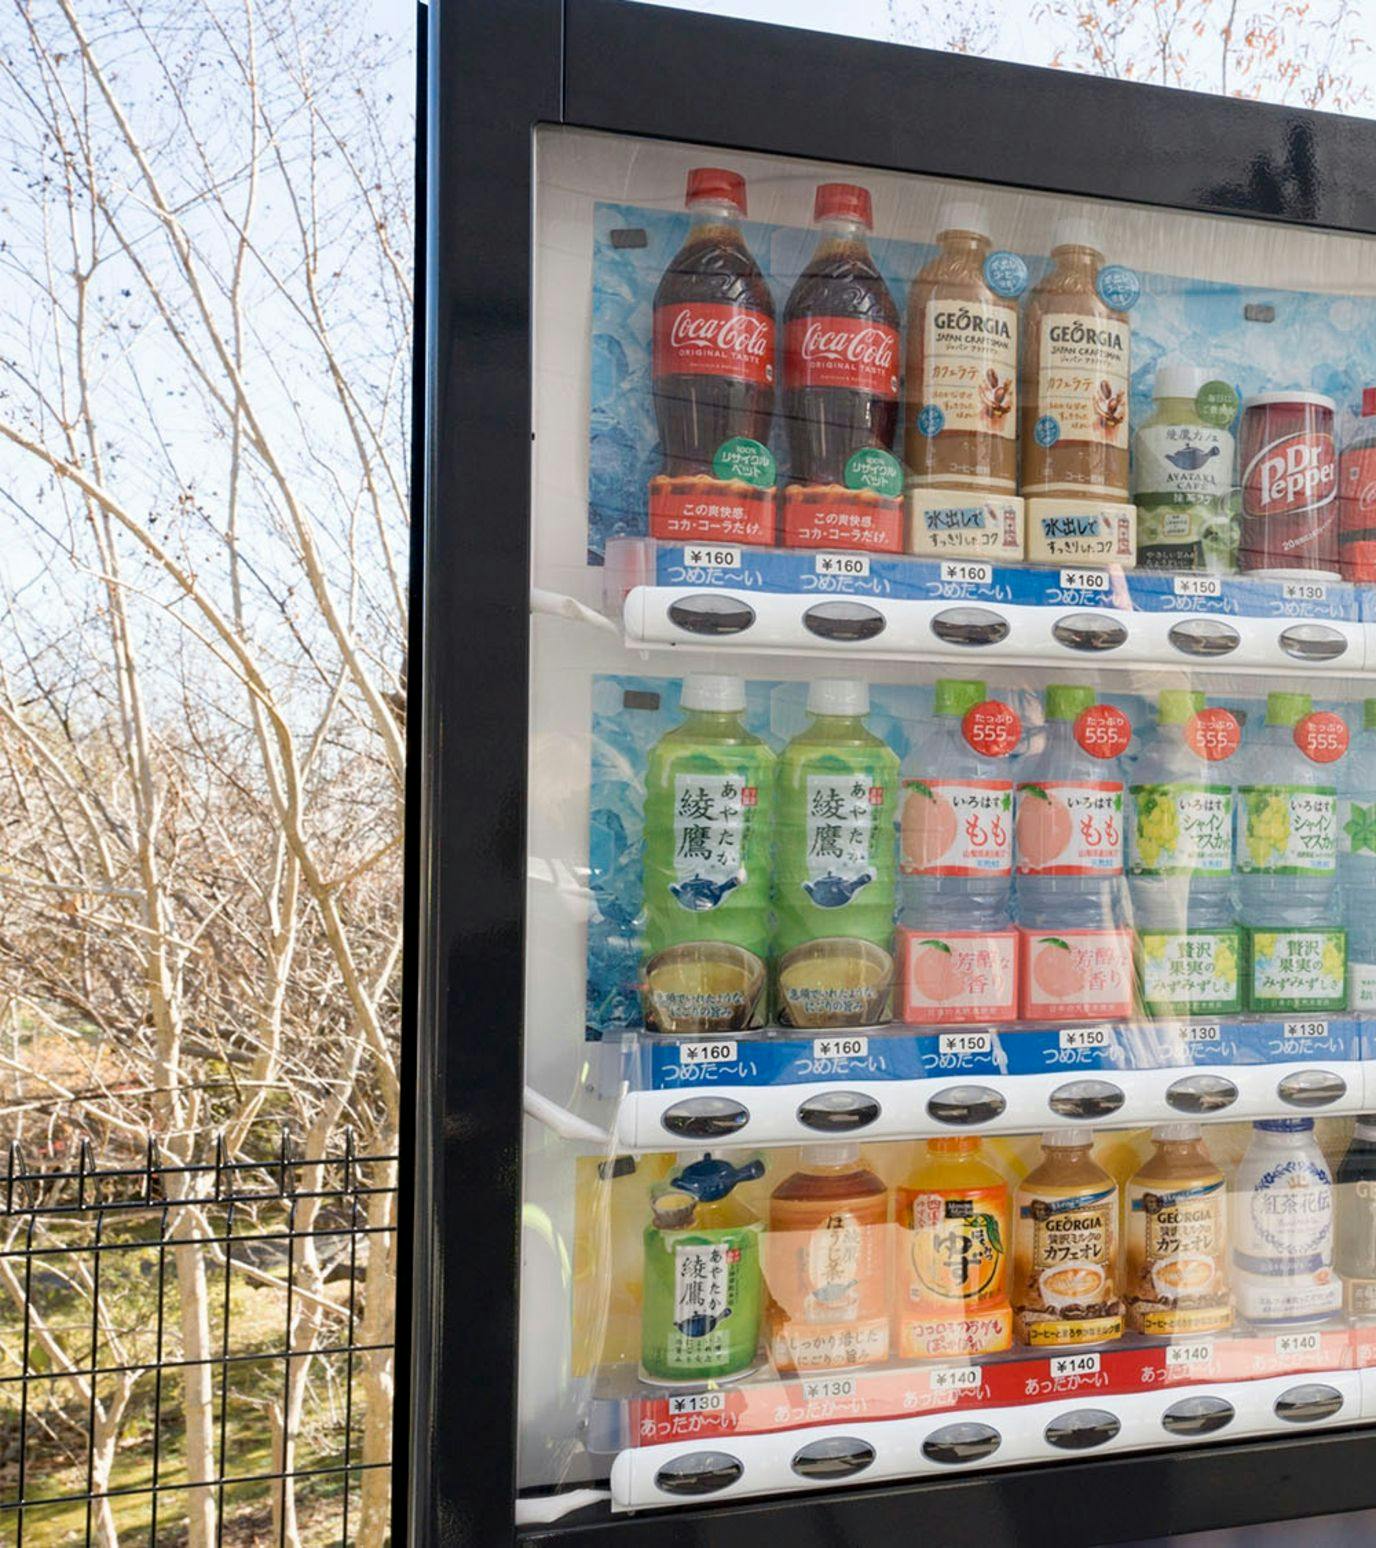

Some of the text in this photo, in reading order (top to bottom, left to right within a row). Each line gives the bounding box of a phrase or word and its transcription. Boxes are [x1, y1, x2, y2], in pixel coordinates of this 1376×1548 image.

[934, 307, 1011, 339] GEORGIA
[671, 309, 767, 356] Coca-Cola
[1050, 320, 1123, 351] GEORGIA
[802, 323, 894, 368] Coca-Cola
[679, 350, 760, 364] ORIGINAL TASTE
[810, 361, 886, 376] ORIGINAL TASTE
[932, 365, 979, 381] カフェラテ
[721, 452, 770, 467] リサイクル
[1287, 444, 1323, 472] Dr
[731, 464, 760, 478] ペット
[852, 463, 897, 477] リサイクル
[1261, 456, 1334, 507] Pepper
[926, 509, 984, 529] 水出しで
[1043, 518, 1098, 537] 水出しで
[690, 551, 734, 565] ¥160
[822, 559, 863, 573] ¥160
[947, 567, 986, 580] ¥160
[1065, 573, 1104, 588] ¥160
[1181, 581, 1216, 593] ¥150
[1288, 586, 1323, 598] ¥130
[975, 713, 1013, 725] たっぷり
[1087, 717, 1124, 727] たっぷり
[1196, 721, 1234, 731] たっぷり
[1307, 723, 1344, 733] たっぷり
[953, 796, 1001, 808] いろはす
[1067, 796, 1112, 808] いろはす
[677, 787, 719, 860] 綾鷹
[717, 781, 738, 866] あやたか
[809, 786, 848, 859] 綾鷹
[848, 781, 867, 864] あやたか
[965, 813, 1008, 846] もも
[1080, 814, 1119, 846] もも
[1294, 815, 1332, 832] シャイン
[1279, 958, 1323, 974] 果実の
[1179, 1027, 1216, 1040] ¥130
[1287, 1023, 1324, 1036] ¥130
[946, 1037, 985, 1050] ¥150
[1066, 1032, 1104, 1045] ¥150
[687, 1045, 730, 1060] ¥160
[819, 1040, 861, 1055] ¥160
[1261, 1191, 1330, 1215] 紅茶花伝
[1045, 1215, 1102, 1231] GEORGIA
[1157, 1208, 1211, 1224] GEORGIA
[1156, 1236, 1213, 1252] カフェオレ
[1044, 1246, 1102, 1262] カフェオレ
[679, 1255, 706, 1307] 綾鷹
[709, 1248, 724, 1311] あやたか
[1281, 1336, 1315, 1349] ¥140
[1172, 1347, 1208, 1360] ¥140
[1056, 1357, 1095, 1371] ¥140
[936, 1371, 976, 1386] ¥140
[807, 1382, 851, 1398] ¥130
[673, 1396, 720, 1411] ¥130
